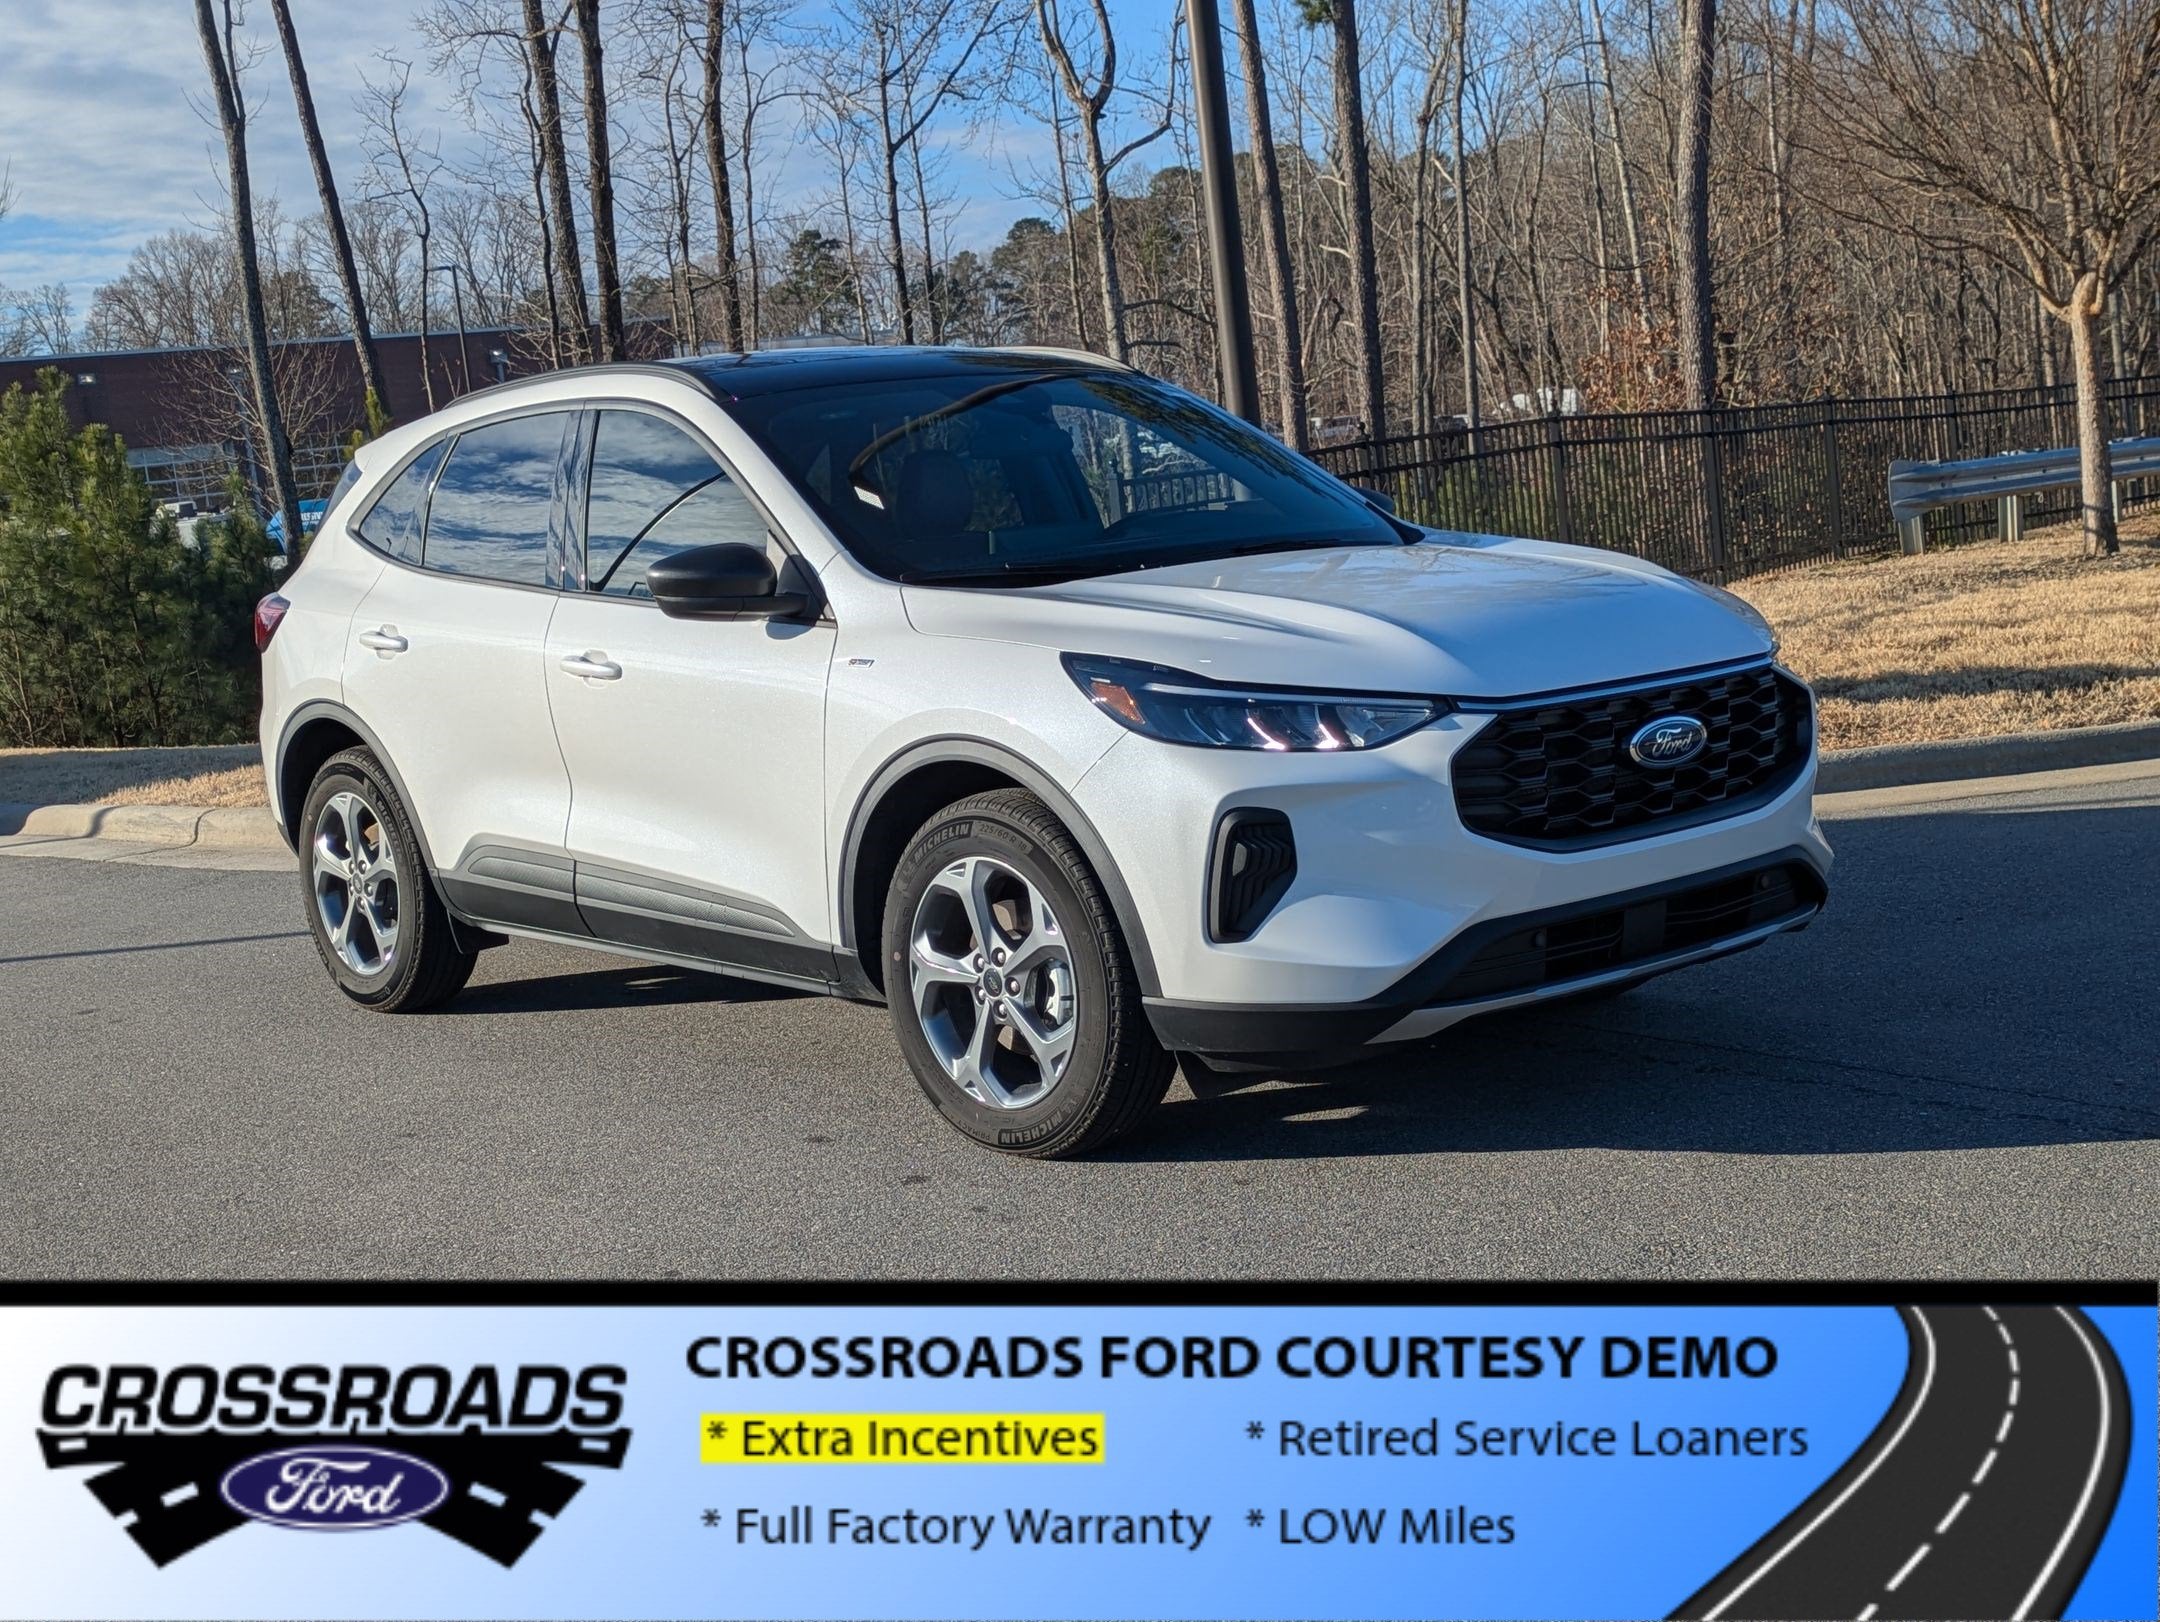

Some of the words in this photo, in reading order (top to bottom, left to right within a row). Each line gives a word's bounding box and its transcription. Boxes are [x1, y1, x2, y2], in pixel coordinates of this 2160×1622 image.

[1651, 727, 1693, 758] Ford
[376, 800, 402, 860] MICHELIN
[914, 823, 969, 861] MICHELIN
[1000, 1110, 1063, 1144] MICHELIN
